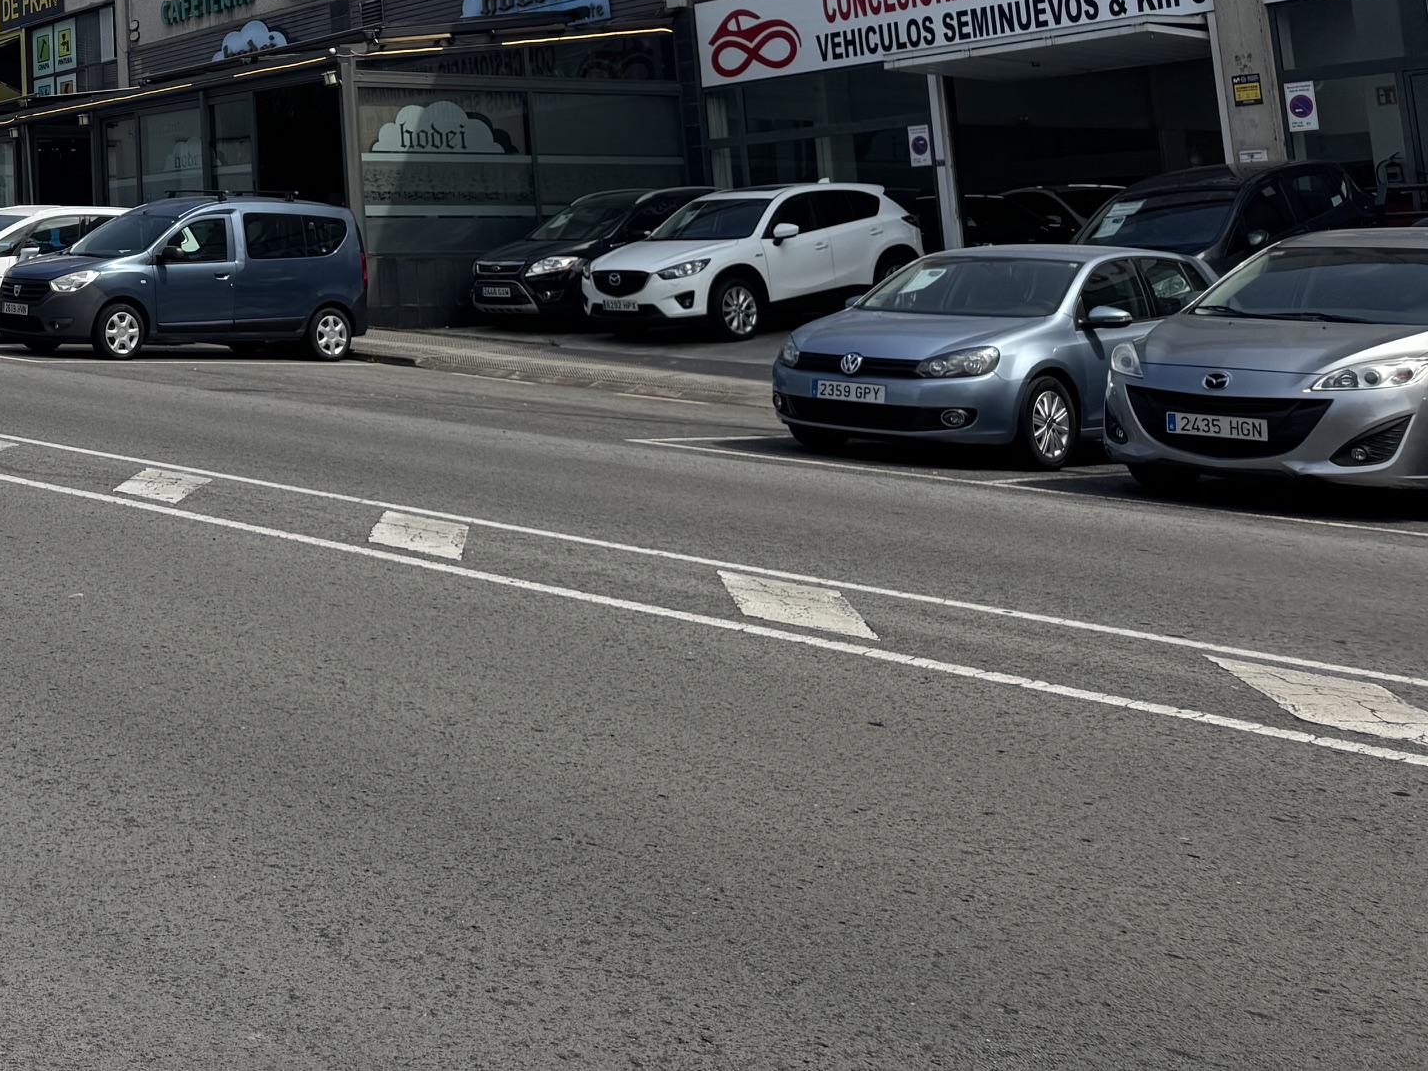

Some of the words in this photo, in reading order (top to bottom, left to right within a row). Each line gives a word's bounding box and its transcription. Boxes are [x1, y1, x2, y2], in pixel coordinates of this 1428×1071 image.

[816, 15, 936, 62] VEHICULOS
[399, 121, 467, 151] hodei
[820, 383, 851, 398] 2359
[855, 386, 880, 401] GPY
[1180, 416, 1222, 434] 2435
[1229, 420, 1262, 438] HGN
